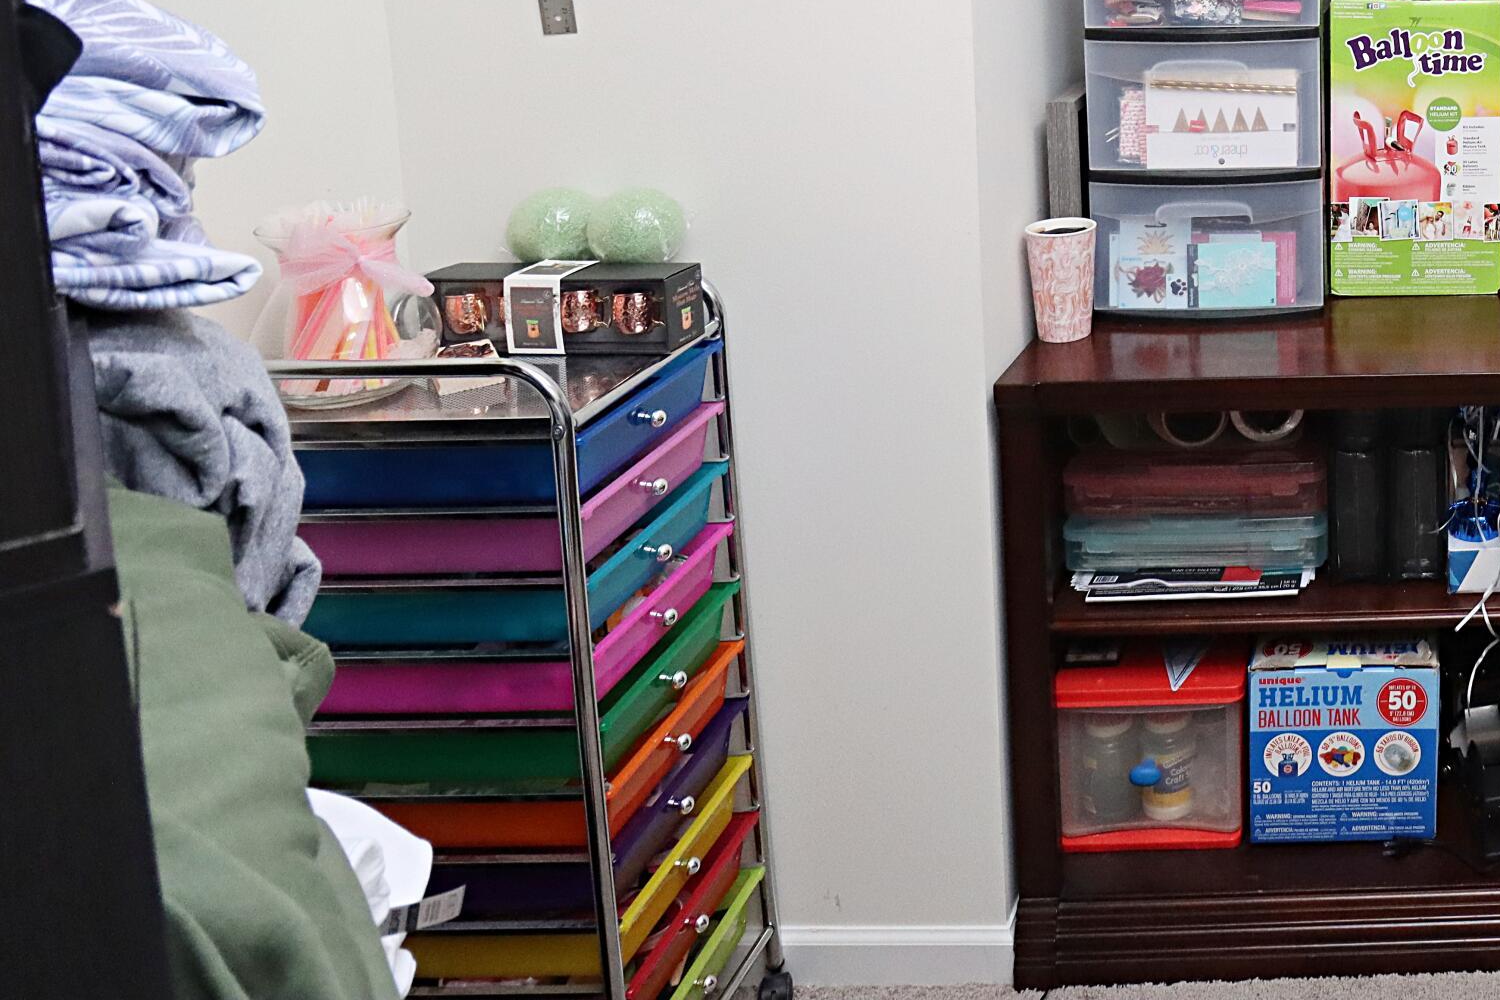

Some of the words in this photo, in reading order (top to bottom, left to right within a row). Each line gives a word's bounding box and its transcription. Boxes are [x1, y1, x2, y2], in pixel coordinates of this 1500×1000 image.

[1347, 29, 1464, 70] Balloon
[1418, 52, 1483, 75] time
[1274, 643, 1301, 656] 50
[1259, 677, 1302, 686] unique
[1259, 685, 1362, 708] HELIUM
[1388, 690, 1417, 710] 50
[1259, 709, 1321, 729] BALLOON
[1327, 708, 1361, 726] TANK
[1253, 781, 1271, 794] 50
